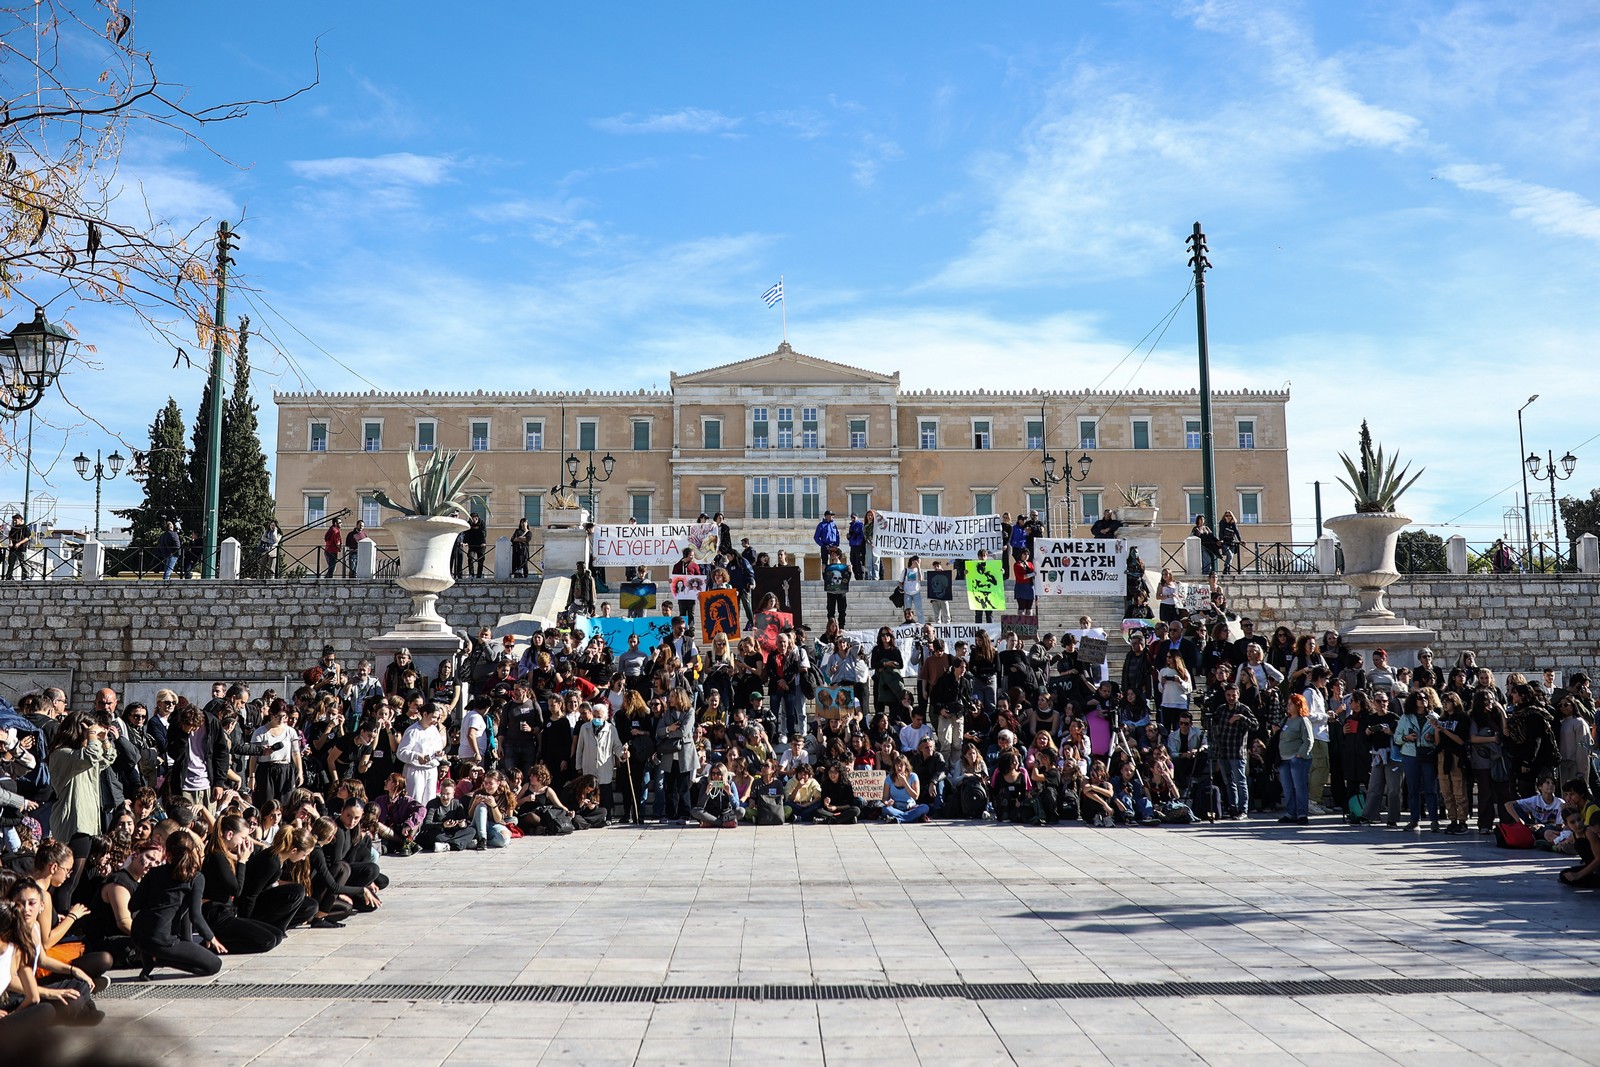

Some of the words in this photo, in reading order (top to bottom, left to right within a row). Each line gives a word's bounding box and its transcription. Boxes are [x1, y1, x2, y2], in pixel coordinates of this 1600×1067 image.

[600, 526, 608, 538] Η
[616, 526, 654, 538] ΤΕΧΝΗ
[662, 525, 691, 537] ΕΙΝΑΙ
[887, 517, 906, 534] ΤΗΝ
[907, 518, 947, 535] ΤΕΧΝΗ
[954, 517, 1001, 534] ΣΤΕΡΕΙΤΕ
[597, 539, 680, 556] ΕΛΕΥΘΕΡΙΑ
[875, 535, 922, 550] ΜΠΡΟΣΤΑ
[929, 538, 944, 551] ΘΑ
[944, 539, 964, 551] ΜΑΣ
[966, 535, 1002, 551] ΒΡΕΙΤΕ
[1051, 542, 1105, 554] ΑΜΕΣΗ
[1041, 555, 1116, 568] ΑΠΟΣΥΡΣΗ
[1040, 570, 1065, 582] ΤΟΥ
[934, 626, 951, 638] ΤΗΝ
